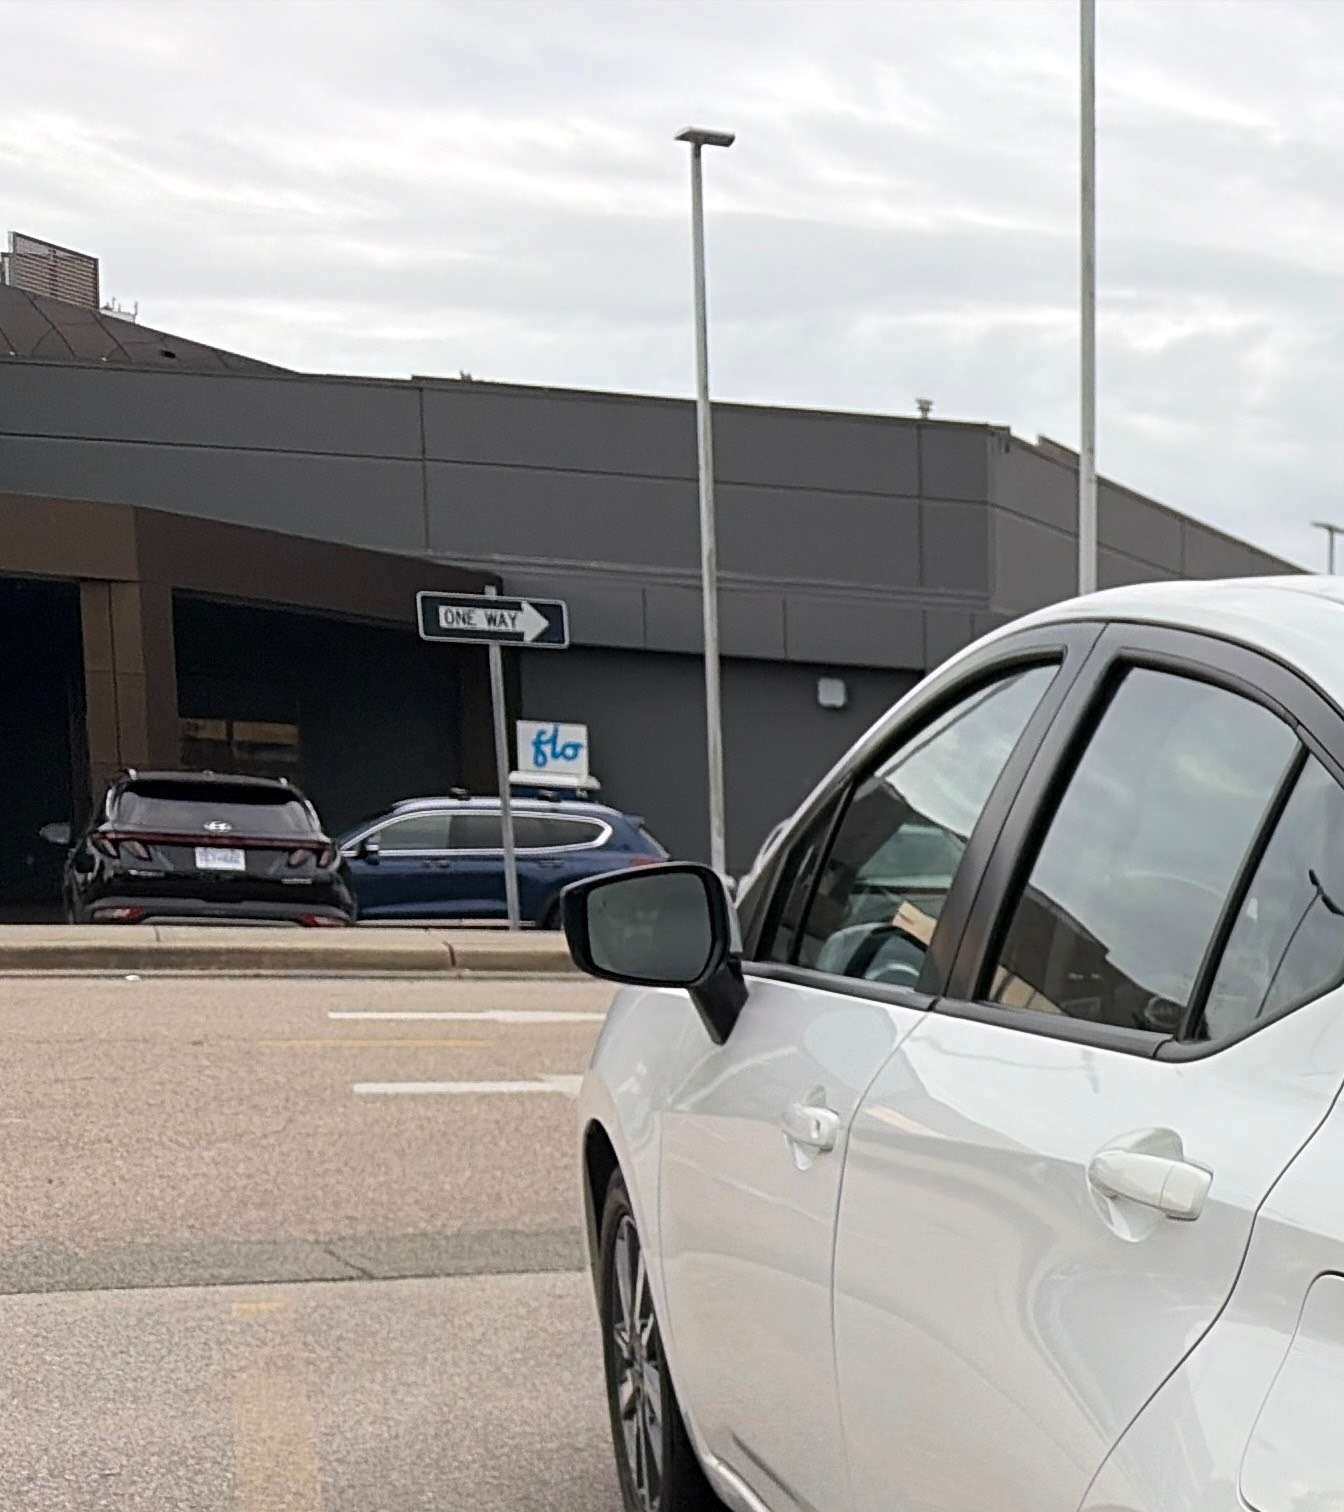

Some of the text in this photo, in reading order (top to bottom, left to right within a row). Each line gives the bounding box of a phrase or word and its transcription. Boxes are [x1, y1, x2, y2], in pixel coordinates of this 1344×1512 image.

[444, 608, 519, 629] ONE WAY
[530, 723, 584, 768] flo
